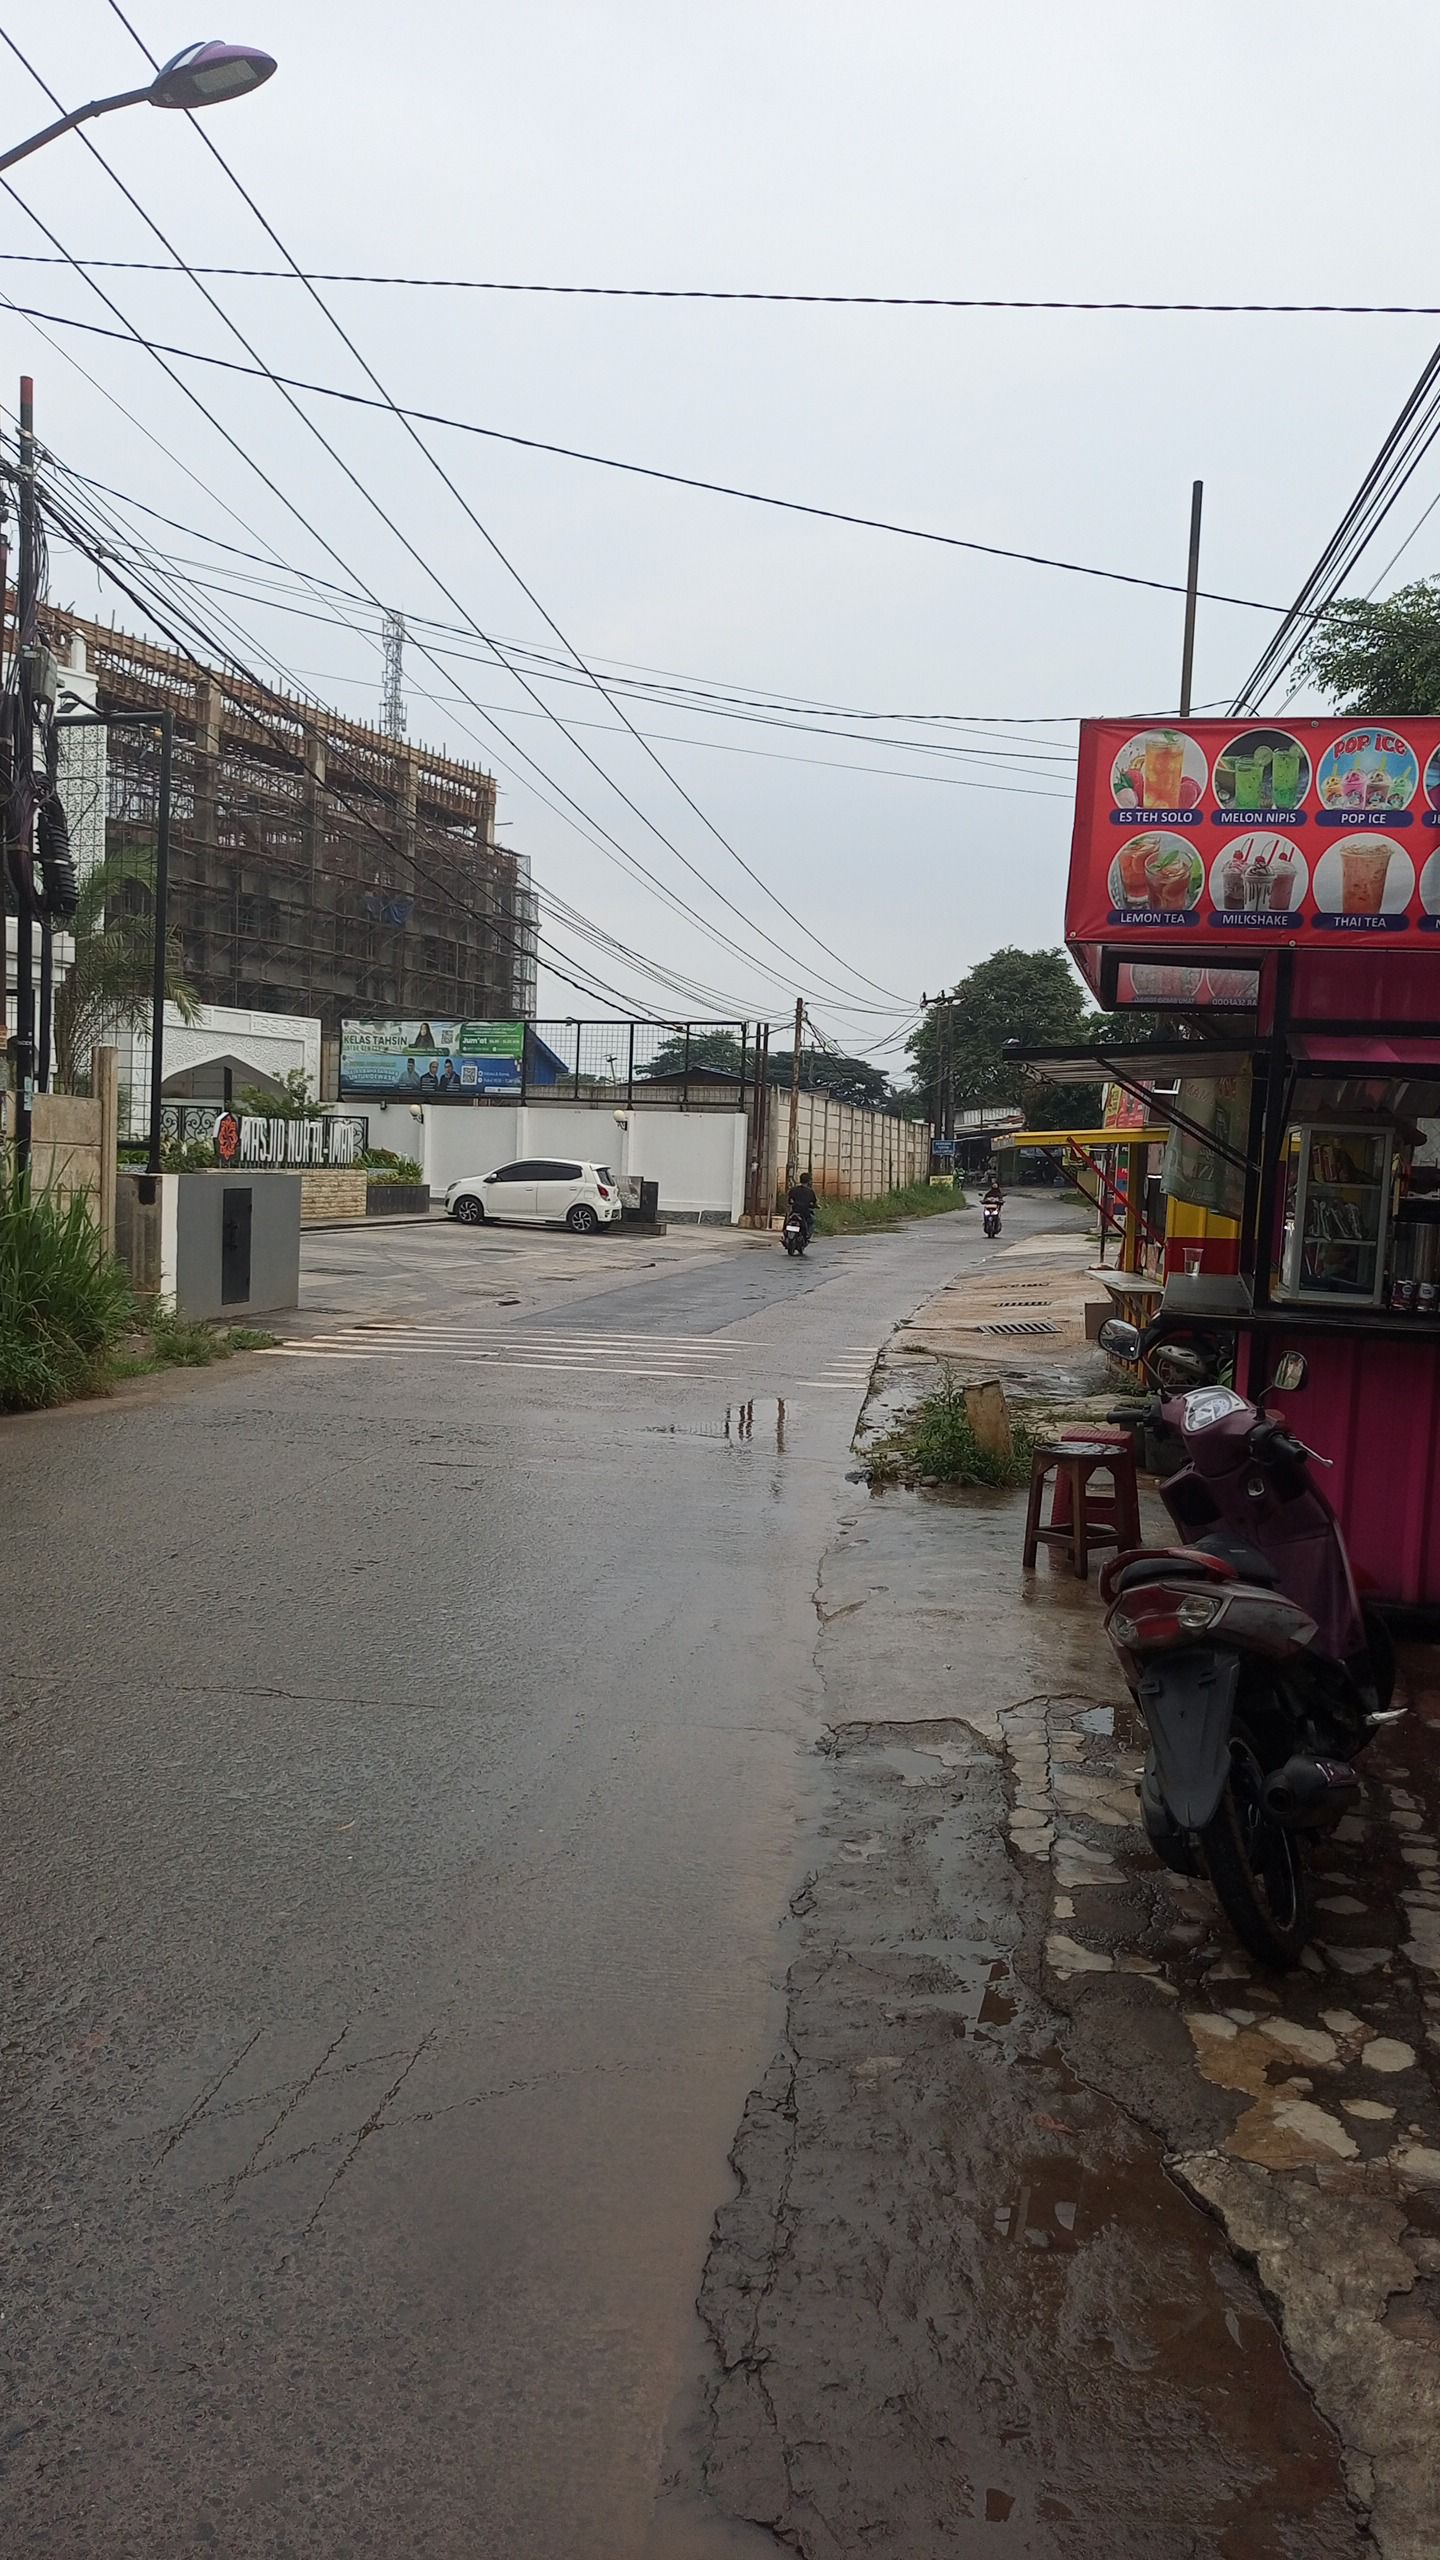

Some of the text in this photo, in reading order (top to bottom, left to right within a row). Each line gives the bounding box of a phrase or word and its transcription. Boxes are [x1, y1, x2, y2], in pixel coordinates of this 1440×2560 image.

[1333, 734, 1370, 760] POP
[1119, 811, 1193, 823] ES TEH SOLO
[1221, 812, 1297, 824] MELON NIPIS
[1341, 813, 1387, 824] POP ICE
[1120, 913, 1185, 924] LEMON TEA
[1222, 914, 1289, 926] MILKSHAKE
[1333, 916, 1387, 928] THAI TEA
[343, 1035, 408, 1046] KELAS TAHSIN
[239, 1116, 355, 1164] MASJID NUR AL-IMAN
